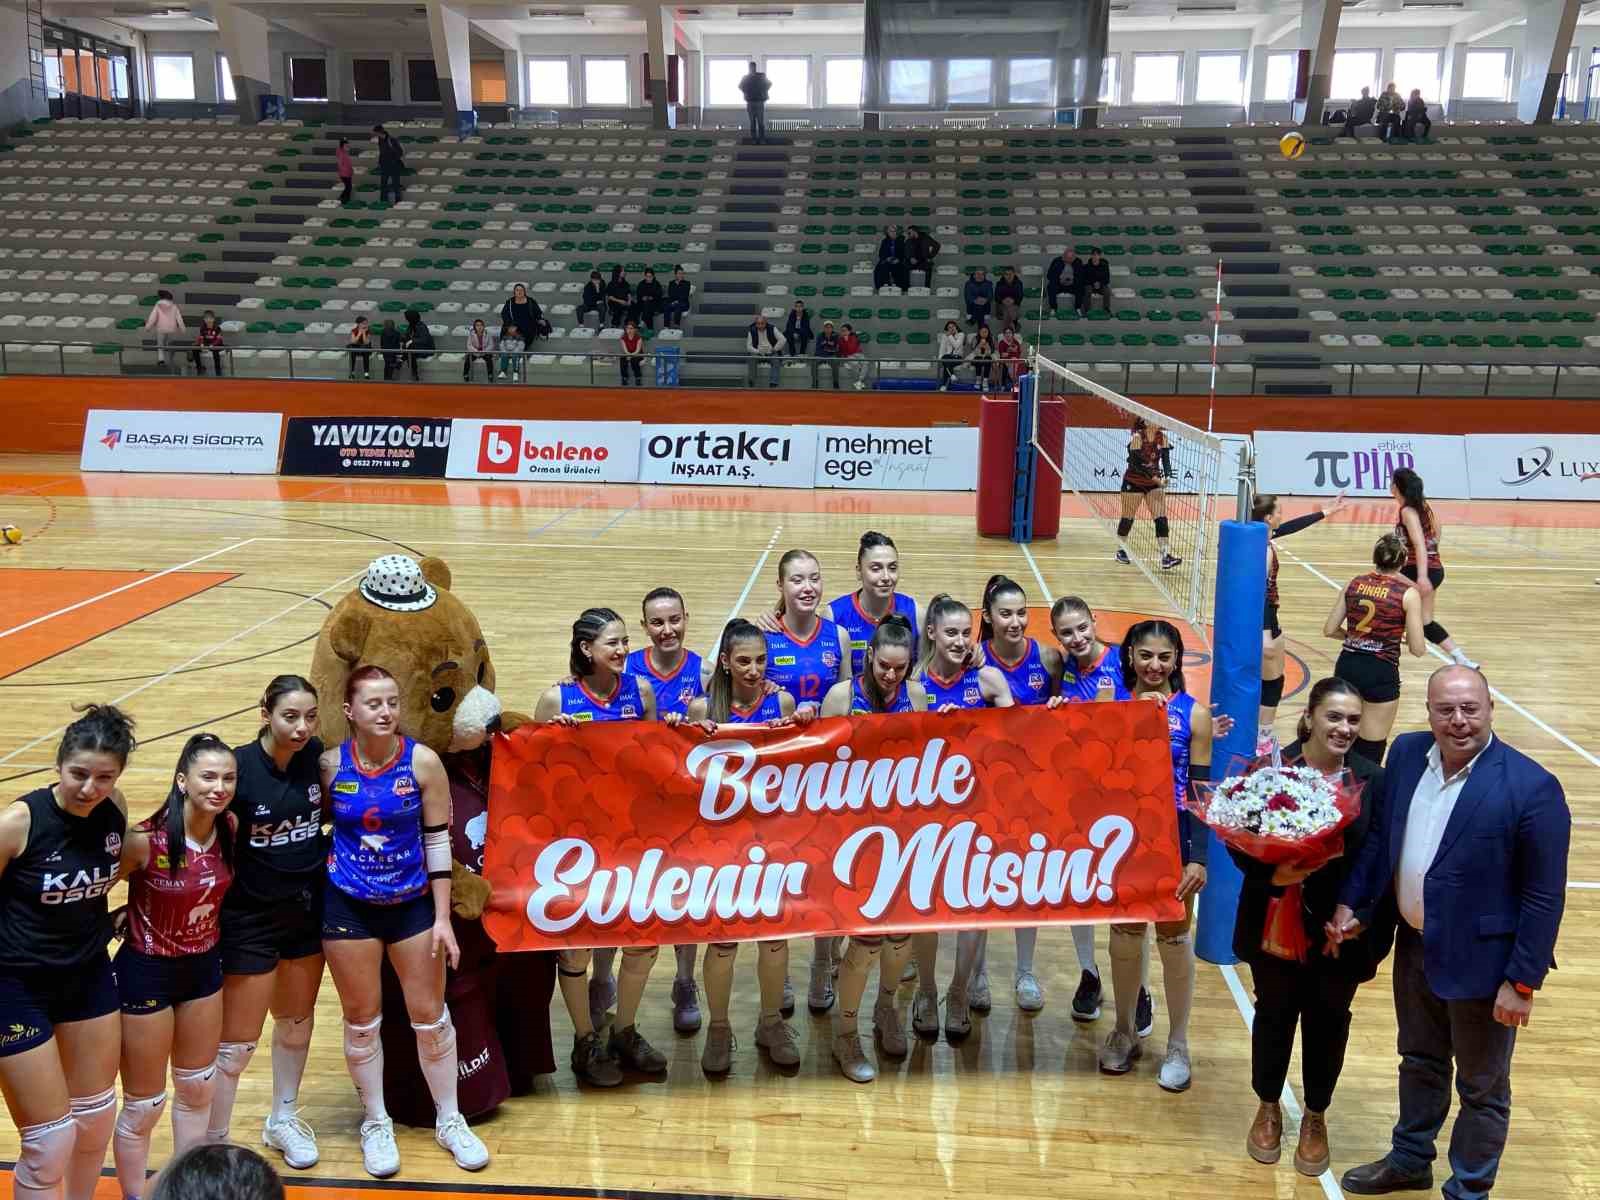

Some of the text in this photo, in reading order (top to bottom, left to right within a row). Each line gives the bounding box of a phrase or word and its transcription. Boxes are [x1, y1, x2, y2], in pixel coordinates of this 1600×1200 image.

[126, 433, 264, 446] BAŞARI SİGORTA
[524, 440, 609, 461] baleno
[648, 430, 791, 466] ortakçı
[825, 433, 933, 455] mehmet
[529, 464, 601, 475] Orman Ürünleri
[671, 461, 755, 479] İNŞAAT A.Ş.
[824, 460, 873, 481] ege
[1355, 600, 1376, 633] 2
[799, 673, 821, 698] 12
[686, 738, 975, 822] Benimle
[251, 808, 321, 835] KALE
[363, 806, 383, 832] 6
[250, 822, 320, 848] OSGB
[43, 862, 120, 891] KALE
[526, 814, 1134, 932] Evlenir Misin?
[199, 872, 217, 904] 7
